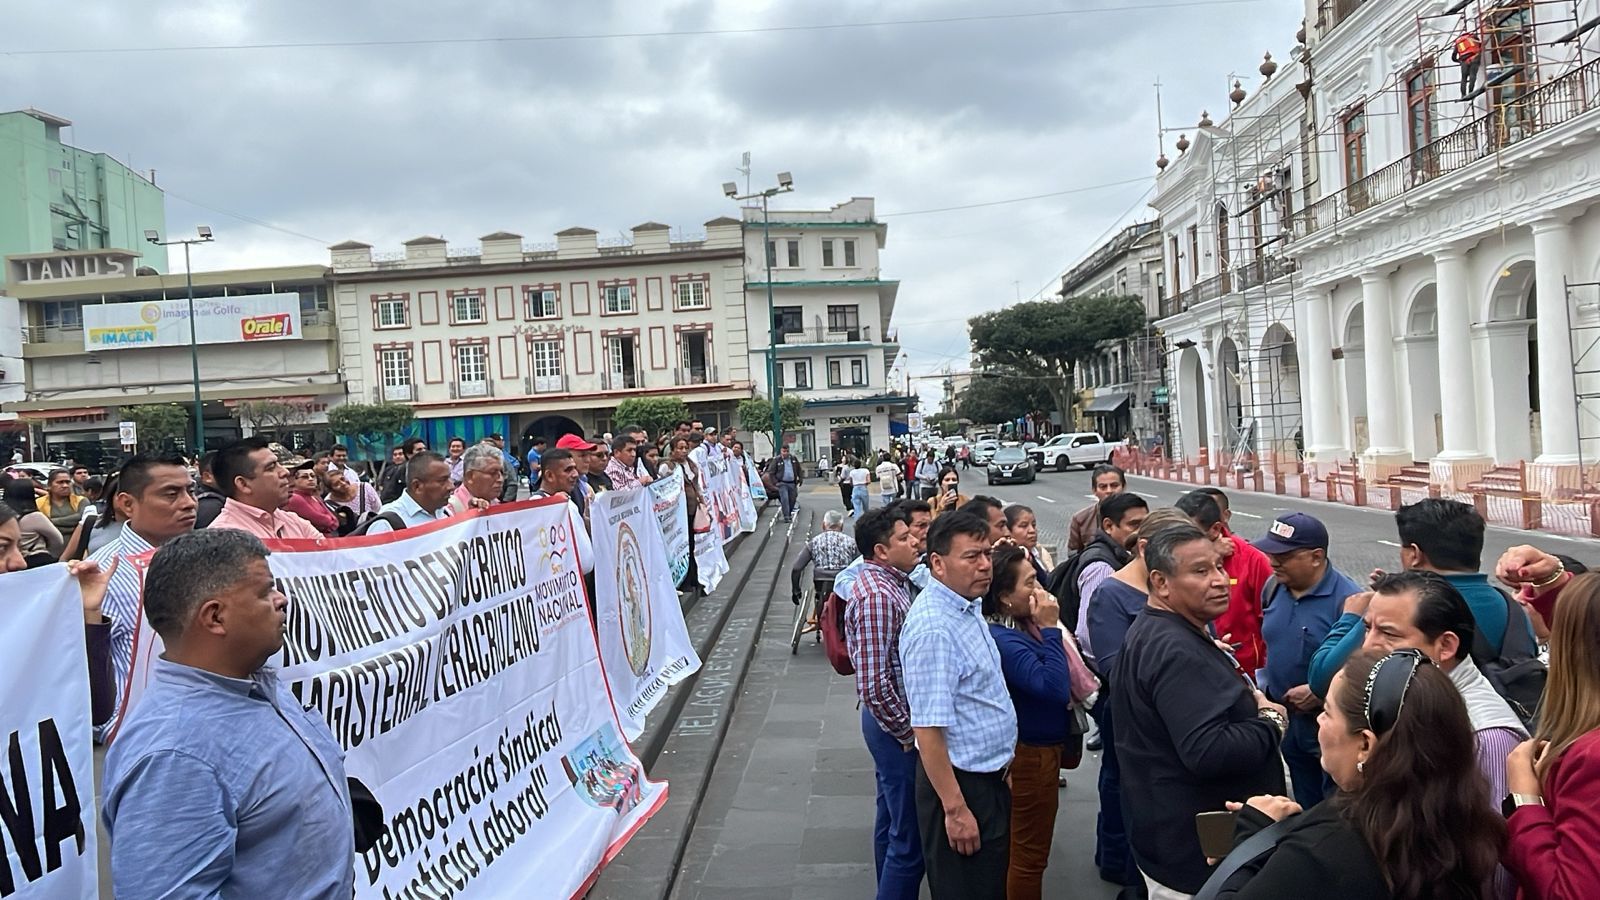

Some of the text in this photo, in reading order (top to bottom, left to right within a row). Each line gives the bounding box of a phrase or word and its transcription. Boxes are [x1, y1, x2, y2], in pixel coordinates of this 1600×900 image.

[102, 330, 154, 344] IMAGEN
[830, 415, 871, 425] DEVLYN
[276, 520, 526, 668] MOVIMIENTO DEMOCRÁTICO
[538, 590, 582, 627] NACINAL
[432, 594, 540, 703] VERACRUZANO
